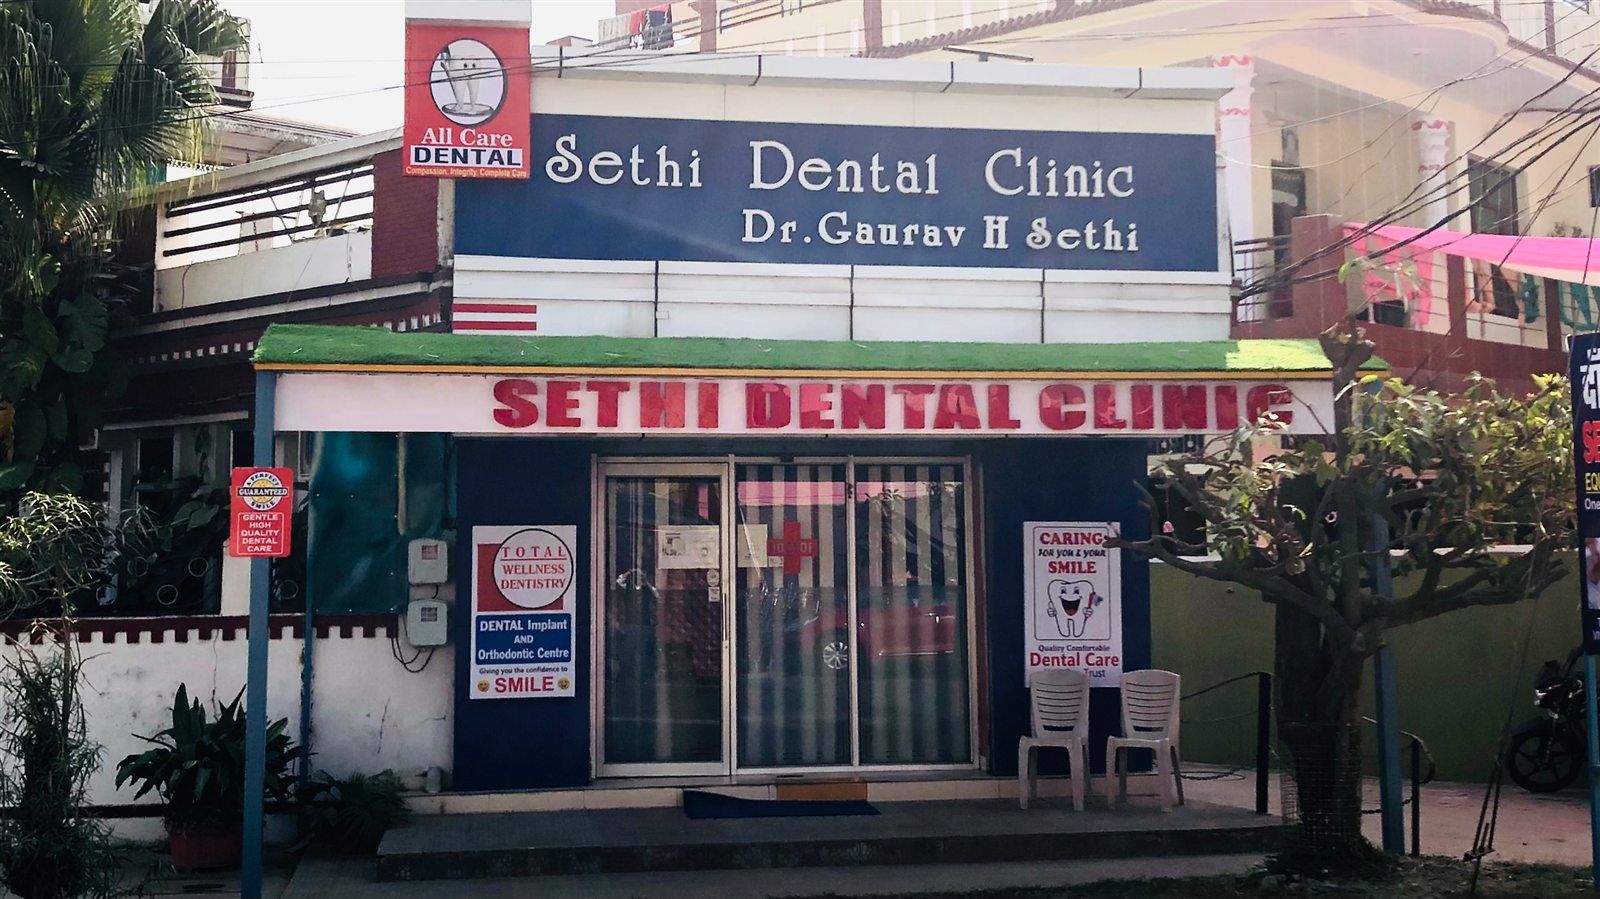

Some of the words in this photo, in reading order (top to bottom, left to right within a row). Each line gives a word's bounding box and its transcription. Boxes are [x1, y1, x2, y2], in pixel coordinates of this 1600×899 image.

[421, 127, 454, 145] All
[459, 128, 513, 147] Care
[414, 147, 521, 166] DENTAL
[545, 133, 703, 188] Sethi
[749, 140, 940, 195] Dental
[984, 147, 1135, 198] Clinic
[479, 168, 510, 178] Complete
[511, 169, 527, 178] Care
[983, 215, 1009, 249] H
[1025, 216, 1139, 251] Sethi
[493, 378, 719, 429] SETHI
[745, 382, 1021, 430] DENTAL
[1038, 383, 1293, 431] CLINIC
[238, 488, 288, 496] GUARANTEED
[251, 500, 276, 509] SMILE
[242, 537, 278, 545] DENTAL
[1039, 532, 1103, 546] CARING
[502, 546, 566, 558] TOTAL
[502, 564, 565, 575] WELLNESS
[1048, 560, 1097, 574] SMILE
[501, 578, 565, 590] DENTISTRY
[479, 620, 524, 632] DENTAL
[527, 619, 568, 632] Implant
[513, 635, 534, 644] AND
[478, 648, 534, 660] Orthodontic
[537, 647, 569, 659] Centre
[1038, 644, 1065, 653] Quality
[1066, 644, 1111, 652] Comfortable
[1030, 652, 1080, 667] Dental
[1085, 653, 1120, 667] Care
[479, 667, 500, 676] Giving
[500, 668, 513, 676] you
[514, 666, 524, 674] the
[526, 666, 560, 674] confidence
[495, 676, 554, 693] SMILE
